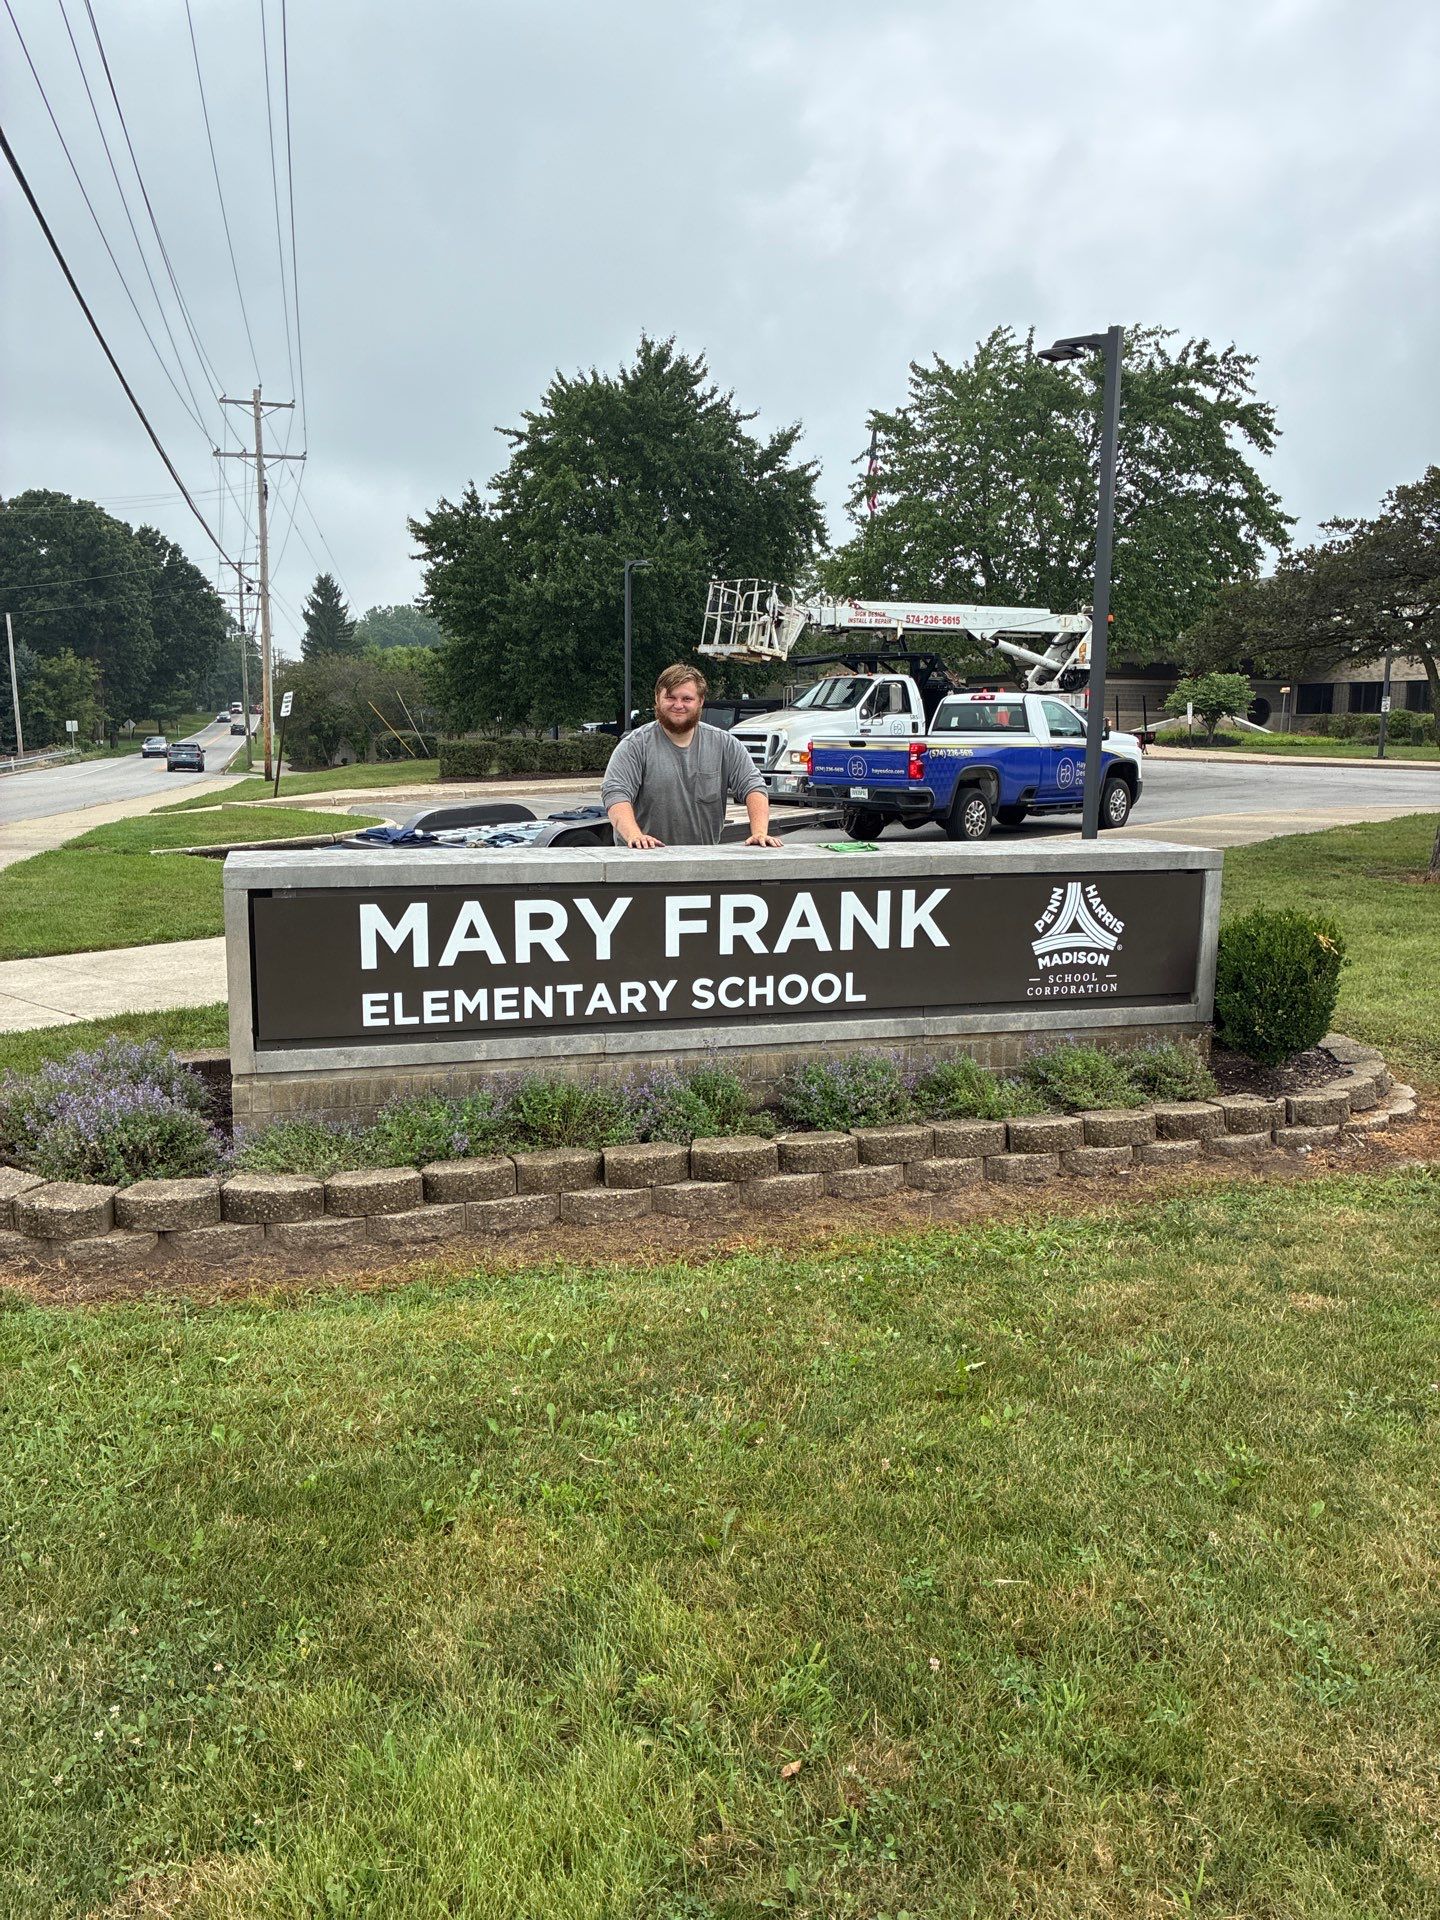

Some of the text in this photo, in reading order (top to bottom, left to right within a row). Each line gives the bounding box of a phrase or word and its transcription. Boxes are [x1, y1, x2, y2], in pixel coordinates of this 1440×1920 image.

[905, 614, 961, 625] 574-236-5615
[930, 749, 947, 759] (574)
[1034, 887, 1064, 933] PENN
[1085, 884, 1125, 934] HARRIS
[360, 888, 952, 970] MARY FRANK
[1037, 951, 1110, 970] MADISON
[1048, 973, 1098, 984] SCHOOL
[1026, 983, 1118, 996] CORPORATION
[361, 972, 867, 1027] ELEMENTARY SCHOOL
